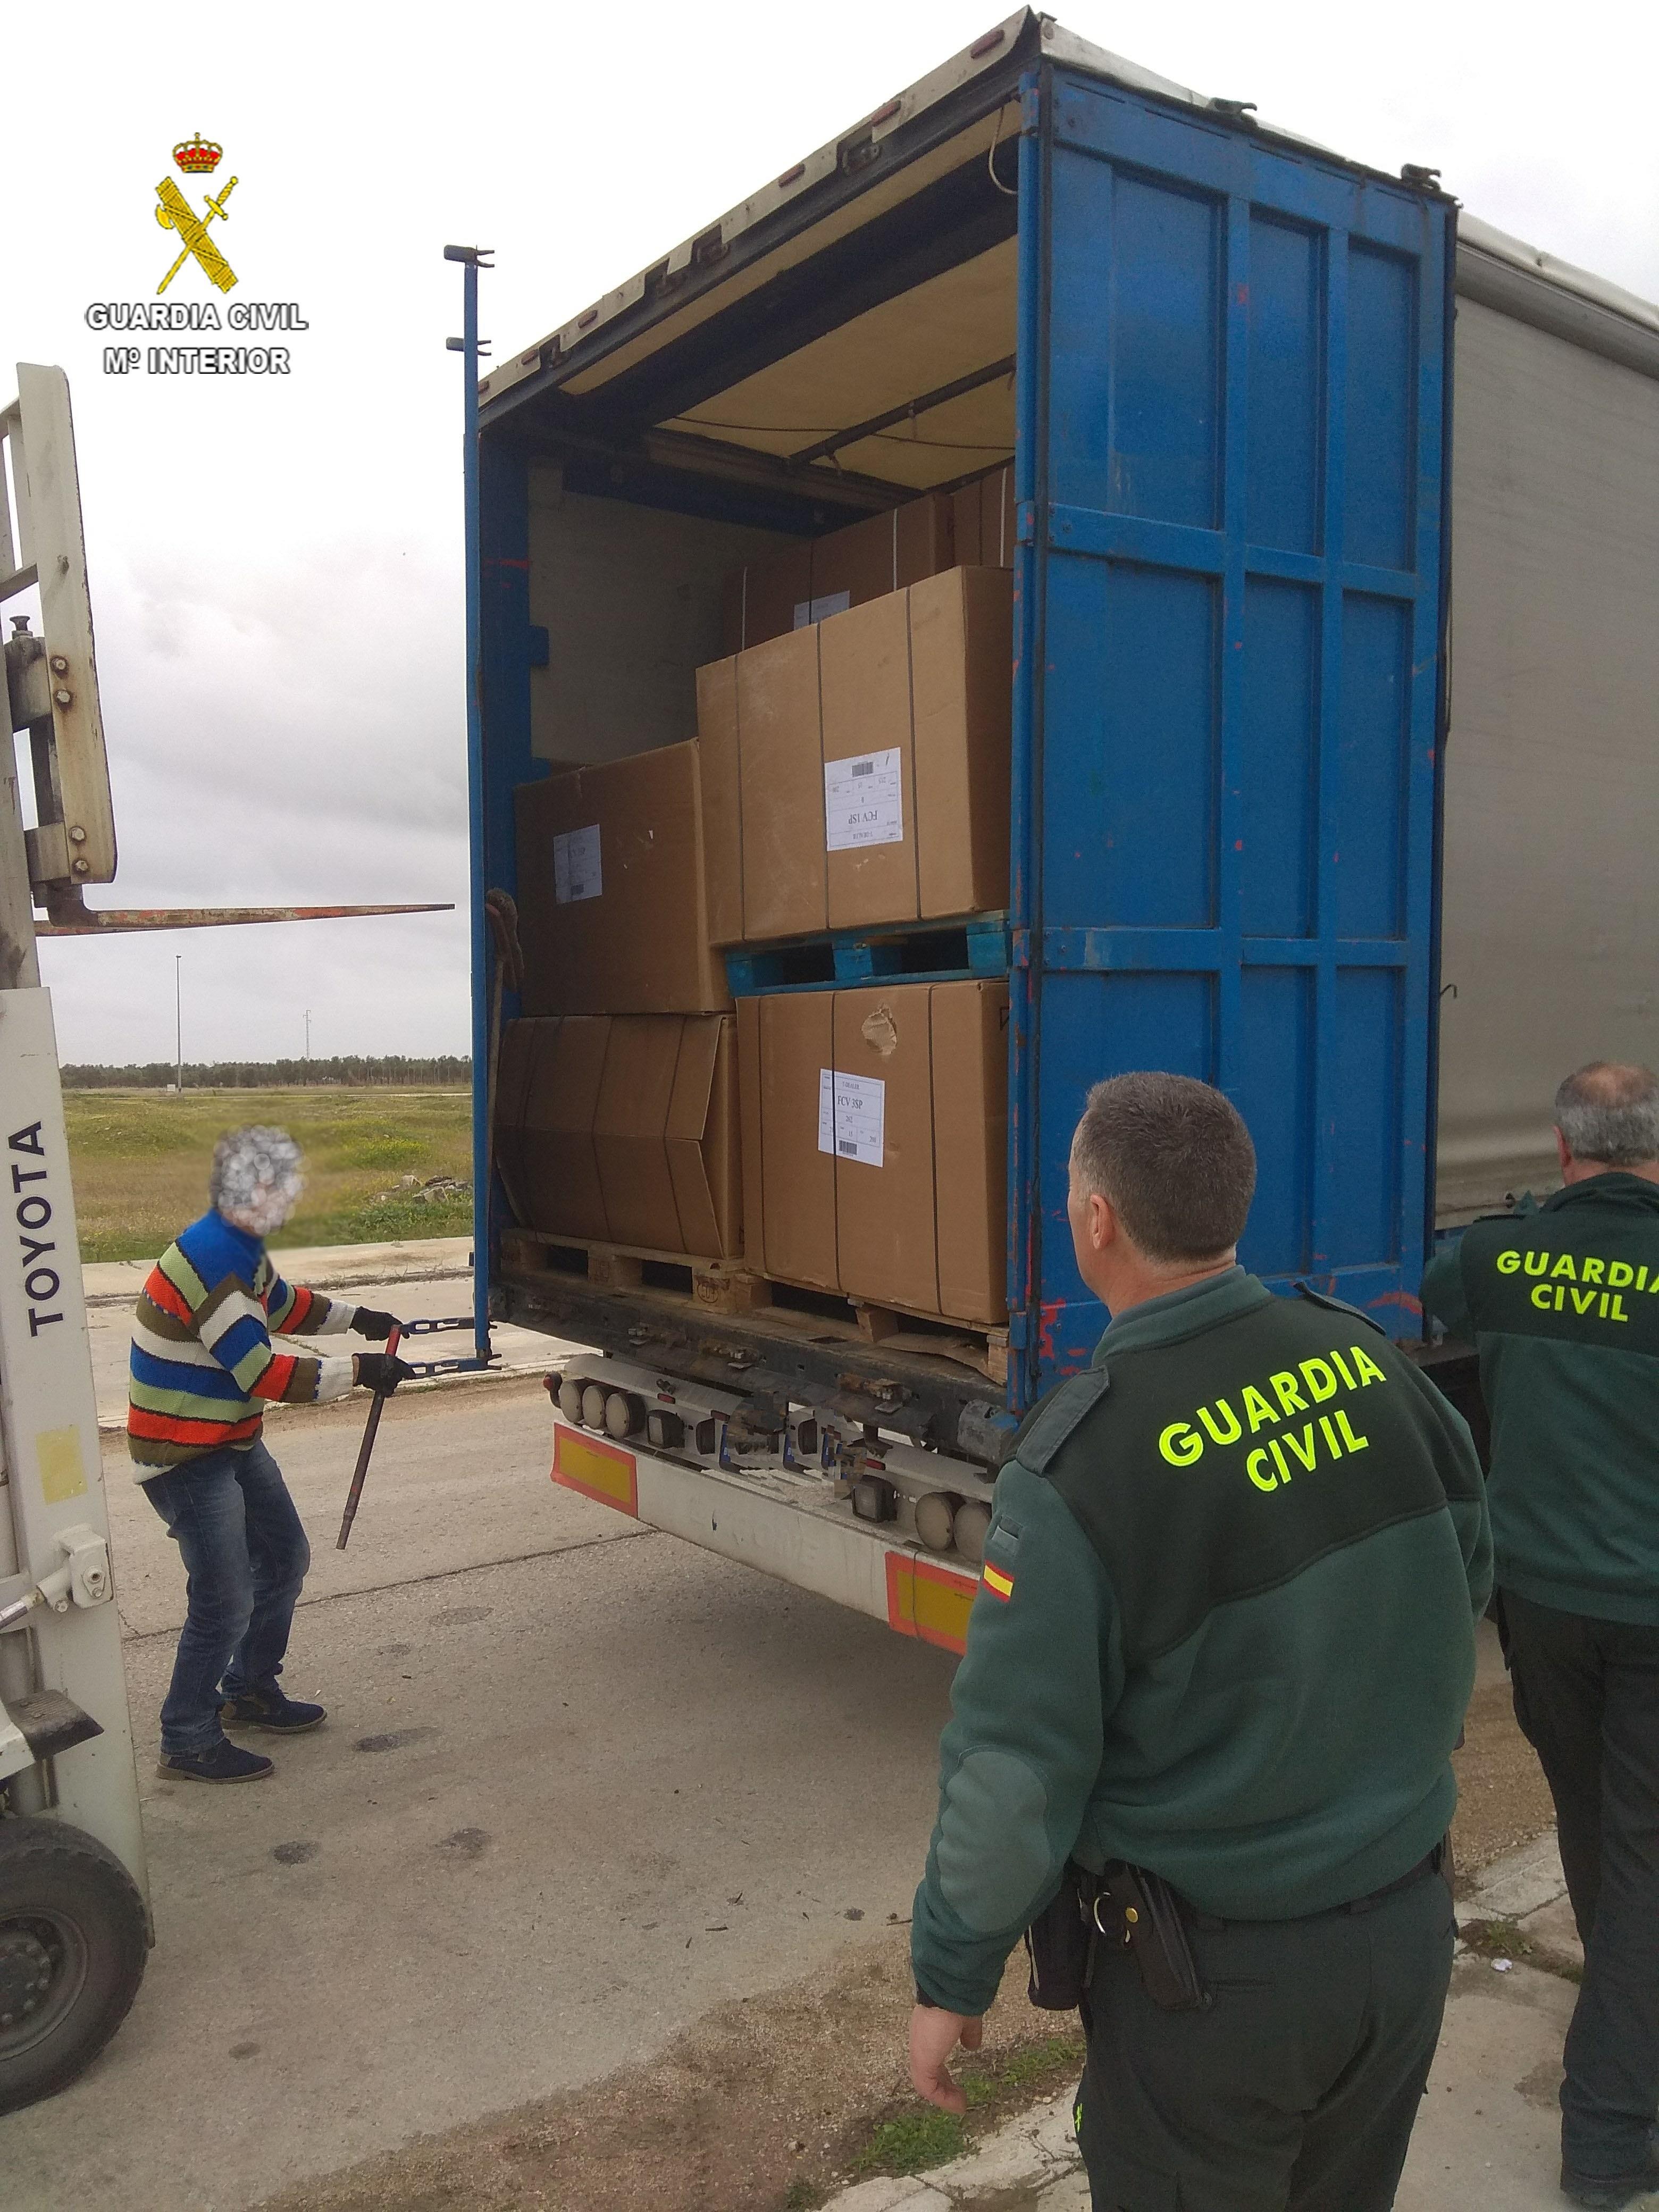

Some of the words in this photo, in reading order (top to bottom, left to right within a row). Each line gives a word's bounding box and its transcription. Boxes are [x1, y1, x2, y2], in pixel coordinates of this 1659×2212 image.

[849, 814, 860, 824] 1SP
[862, 810, 877, 822] FCV
[837, 1095, 851, 1107] FCV
[851, 1099, 863, 1110] 3SP
[8, 1121, 63, 1337] TOYOTA
[1531, 1283, 1629, 1322] CIVIL
[1158, 1346, 1387, 1467] GUARDIA
[1246, 1410, 1369, 1492] CIVIL
